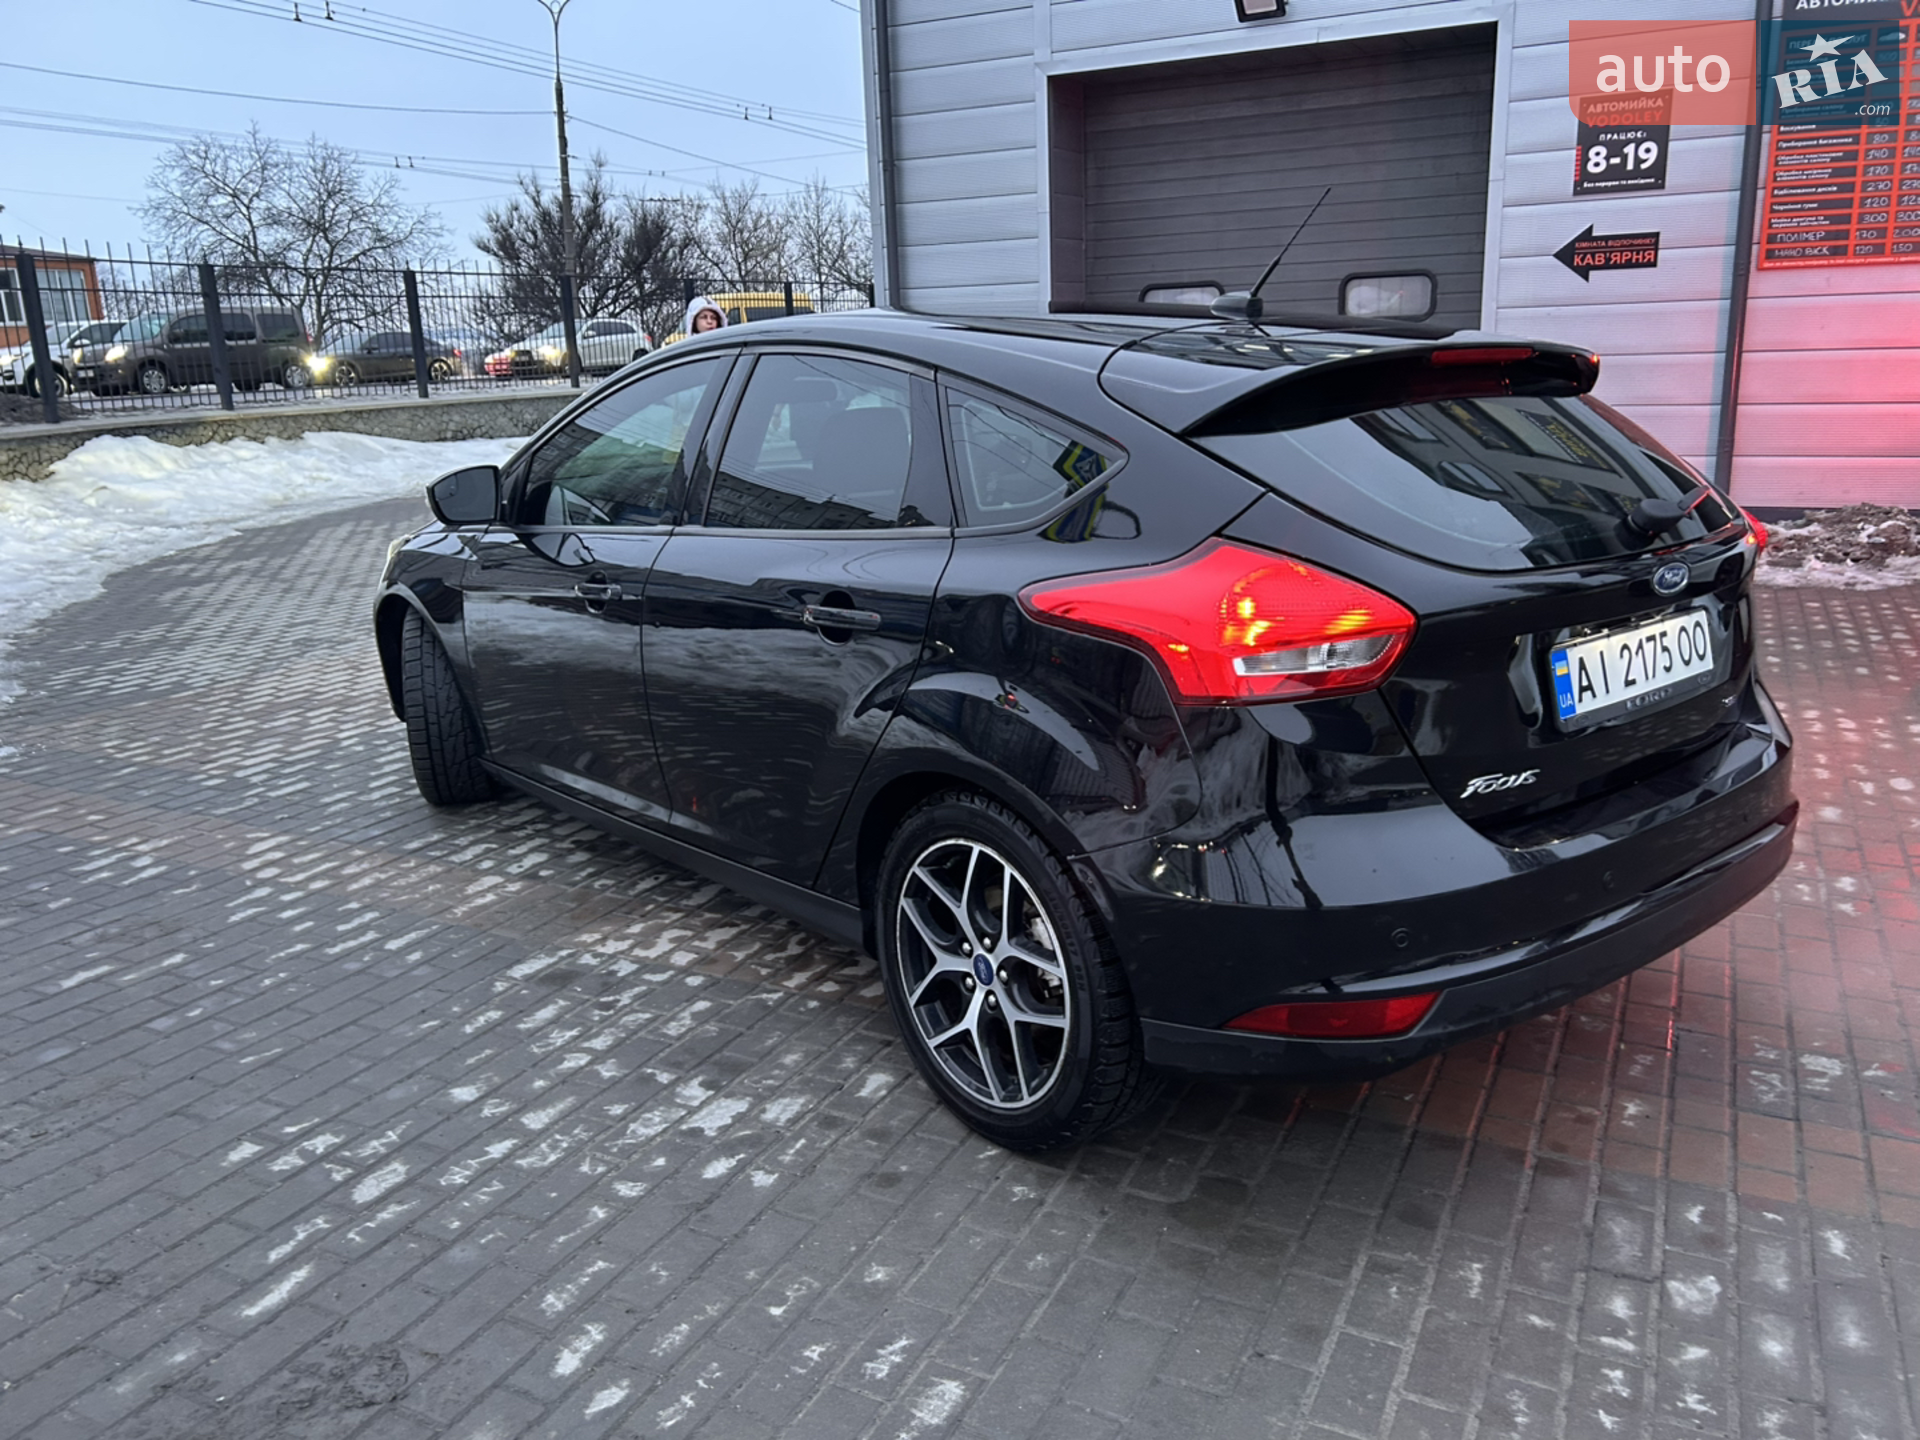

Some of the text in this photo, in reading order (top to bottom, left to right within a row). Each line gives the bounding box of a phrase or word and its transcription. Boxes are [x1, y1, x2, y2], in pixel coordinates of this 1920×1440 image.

[1587, 97, 1664, 114] АВТОМИЙКА
[1587, 110, 1663, 128] VODOLEY
[1586, 140, 1659, 174] 8-19
[1901, 195, 1920, 206] 12
[1573, 250, 1655, 267] КАВ'ЯРНЯ
[1619, 630, 1673, 688] 2175
[1559, 692, 1574, 708] UA
[1460, 769, 1541, 799] Focus
